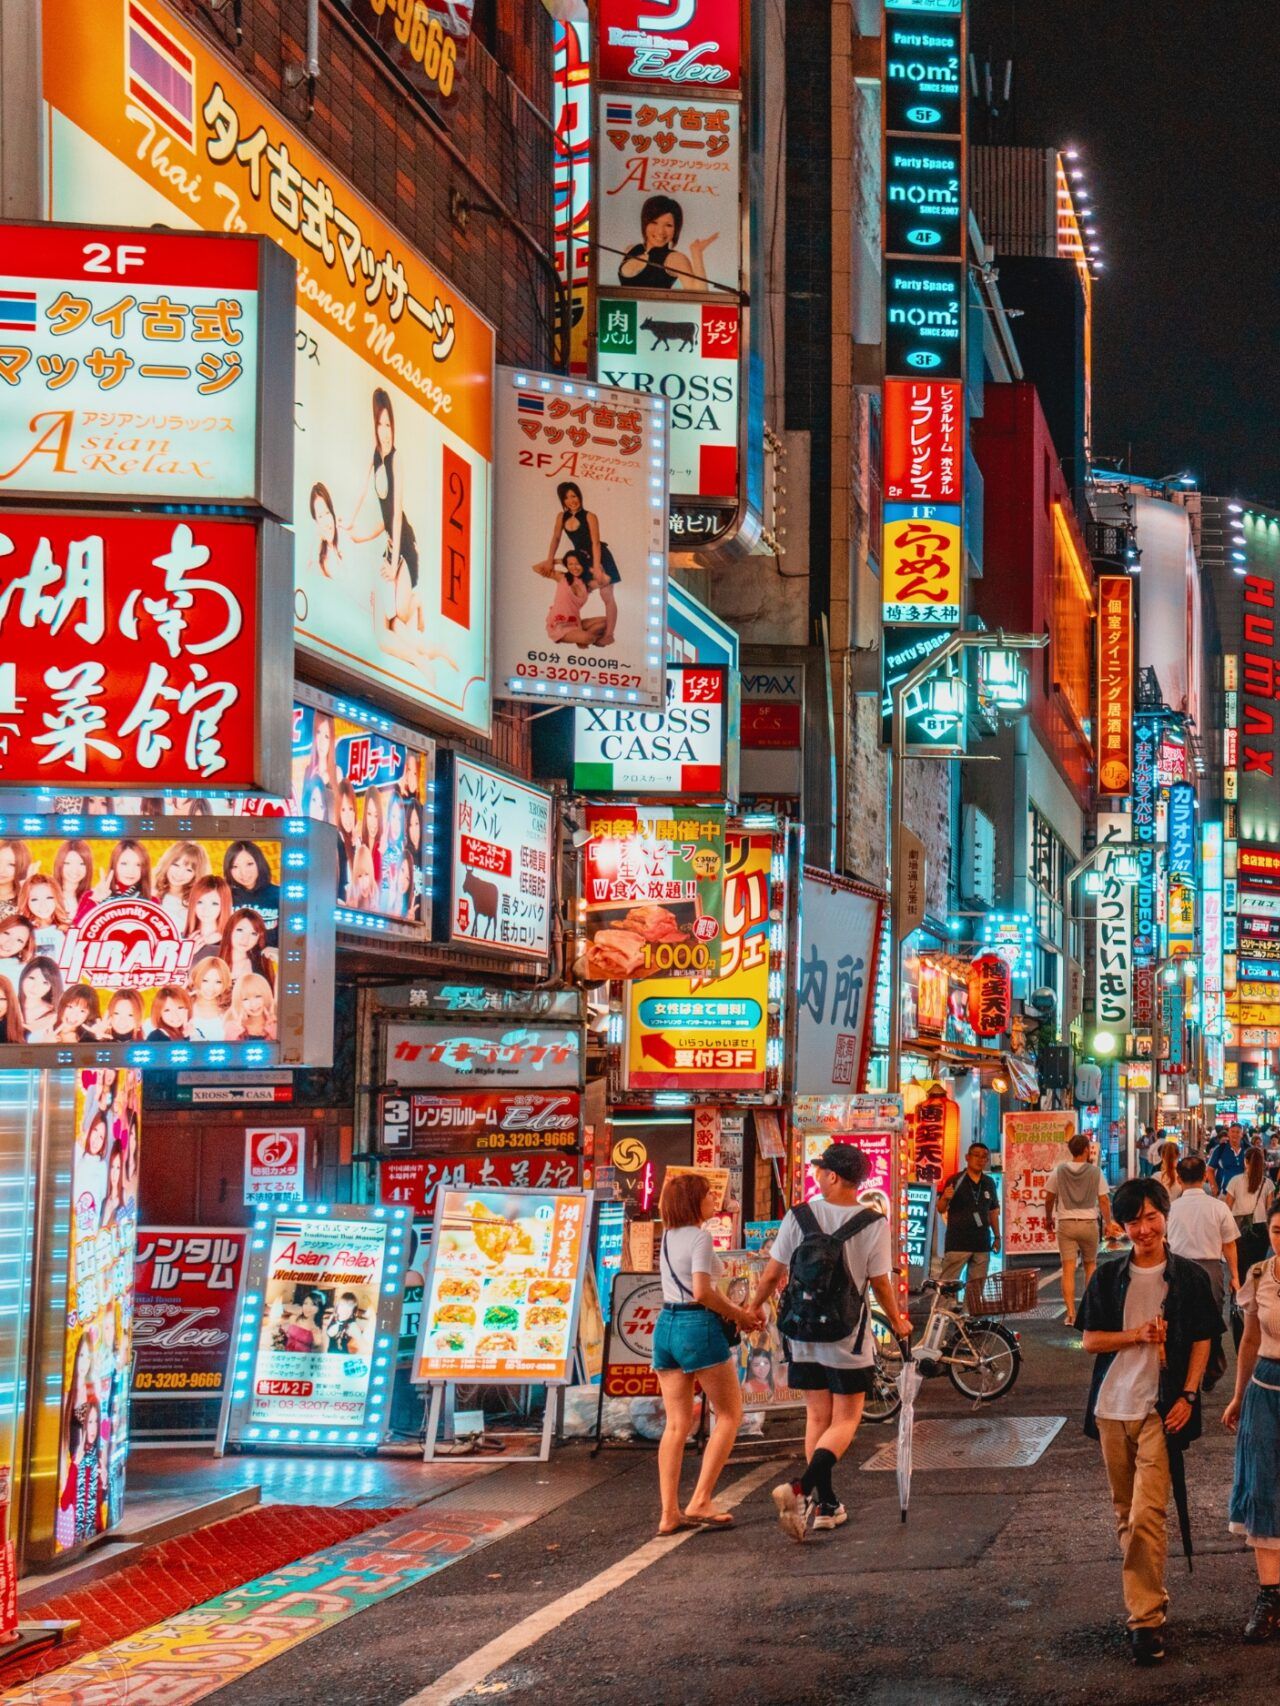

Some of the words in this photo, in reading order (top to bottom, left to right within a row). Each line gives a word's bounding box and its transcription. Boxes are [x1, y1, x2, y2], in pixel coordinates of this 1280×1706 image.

[894, 33, 921, 46] Party
[923, 35, 954, 47] Space
[628, 42, 731, 83] Eden
[919, 83, 940, 92] SINCE
[635, 104, 730, 133] タイ古式
[916, 111, 932, 121] 5F
[606, 130, 730, 158] マッサージ
[652, 158, 731, 171] アジアンリラックス
[895, 156, 921, 168] Party
[923, 158, 954, 170] Space
[607, 157, 696, 195] Asian
[652, 180, 720, 196] Relax
[920, 205, 940, 215] SINCE
[203, 82, 455, 362] タイ古式マッサージ
[916, 232, 932, 243] 4F
[82, 243, 146, 275] 2F
[125, 104, 202, 203] Thai
[365, 312, 453, 414] Massage
[895, 279, 921, 290] Party
[923, 280, 954, 292] Space
[46, 292, 243, 345] タイ古式
[608, 310, 629, 330] 肉
[702, 319, 738, 334] イタリ
[602, 332, 633, 345] バル
[708, 332, 732, 345] アン
[920, 327, 940, 336] SINCE
[0, 345, 243, 394] マッサージ
[916, 354, 932, 366] 3F
[601, 370, 734, 402] XROSS
[81, 411, 235, 433] アジアンリラックス
[549, 399, 642, 434] タイ古式
[941, 386, 953, 452] レンタルルーム
[0, 410, 171, 479] Asian
[518, 419, 642, 455] マッサージ
[910, 385, 932, 499] リフレッシュ
[81, 454, 215, 479] Relax
[519, 451, 552, 468] 2F
[545, 451, 615, 477] Asian
[581, 469, 632, 486] Relax
[941, 458, 953, 495] ホステル
[888, 486, 903, 497] 2F
[912, 507, 936, 518] 1F
[446, 471, 466, 607] 2F
[894, 523, 950, 602] らーめん
[0, 523, 242, 658] 湖南
[886, 605, 958, 621] 博多天神
[528, 651, 560, 663] 60分
[887, 646, 916, 668] Party
[916, 632, 951, 656] Space
[516, 664, 641, 688] 03-3207-5527
[684, 676, 721, 689] イタリ
[1107, 599, 1122, 749] 個室ダイニング居酒屋
[689, 688, 715, 701] アン
[31, 660, 239, 778] 菜館
[584, 708, 711, 733] XROSS
[927, 720, 946, 730] B1
[600, 735, 699, 762] CASA
[347, 740, 401, 784] 即デート
[459, 773, 517, 805] ヘルシー
[458, 800, 501, 840] 肉バル
[591, 820, 720, 842] 肉祭り開催中
[1172, 787, 1190, 857] カラオケ
[1172, 859, 1190, 870] 747
[501, 893, 545, 919] 高タンパク
[1181, 888, 1191, 922] 麻雀
[86, 906, 150, 939] community
[500, 919, 544, 947] 低カロリー
[1100, 824, 1127, 1023] とんかつにいむら
[91, 971, 188, 988] 出会いカフェ
[654, 1003, 746, 1016] 女性は全て無料!
[1242, 1011, 1265, 1020] ゲーム
[679, 1038, 756, 1048] いらっしゃいませ!
[674, 1050, 754, 1068] 受付3F
[246, 1091, 272, 1099] CASA
[384, 1101, 410, 1144] 3F
[415, 1107, 498, 1128] レンタルルーム
[500, 1097, 578, 1131] Eden
[489, 1132, 575, 1147] 03-3203-9666
[252, 1167, 296, 1175] 防犯カメラ
[252, 1182, 296, 1191] すてるな
[275, 1241, 330, 1266] Asian
[332, 1250, 380, 1268] Relax
[151, 1264, 234, 1290] ルーム
[273, 1269, 318, 1283] Welcome
[136, 1373, 222, 1389] 03-3203-9666
[279, 1400, 364, 1412] 03-3207-5527
